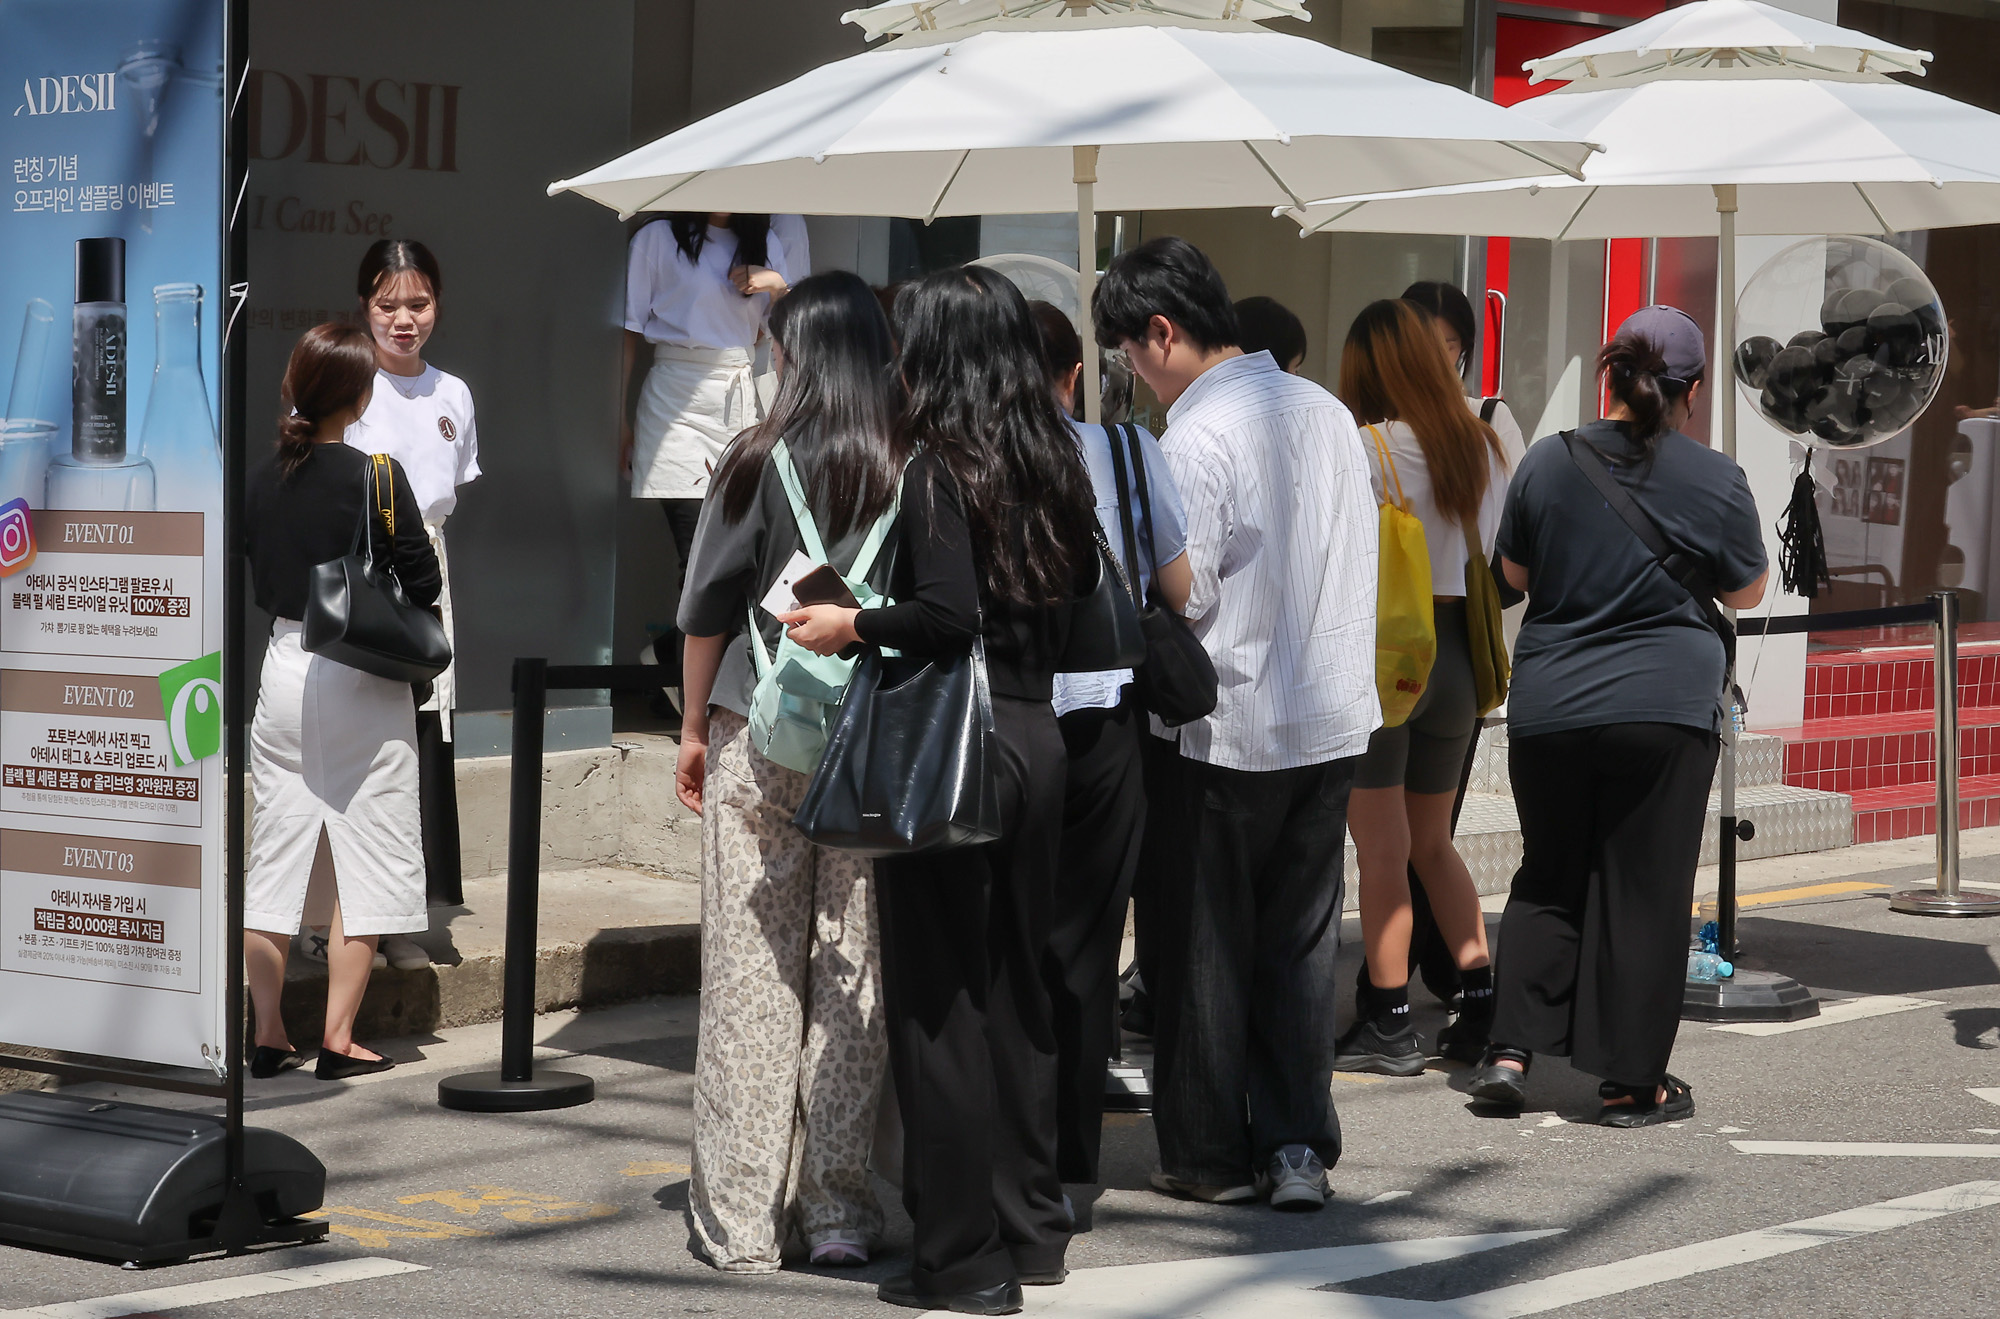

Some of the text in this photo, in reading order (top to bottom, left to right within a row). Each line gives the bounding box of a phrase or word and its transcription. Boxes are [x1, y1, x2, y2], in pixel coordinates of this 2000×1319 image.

[14, 72, 116, 117] ADESII
[14, 154, 78, 184] 런칭 기념
[13, 182, 176, 214] 오프라인 샘플링 이벤트
[275, 196, 336, 235] Can
[345, 200, 393, 237] See
[63, 523, 135, 545] EVENT 01
[26, 574, 173, 595] 아데시 공식 인스타그램 팔로우 시
[12, 592, 189, 616] 블랙 펄 세럼 트라이얼 유닛 100% 증정
[56, 622, 77, 636] 뽑기로
[86, 623, 100, 636] 없는
[100, 624, 121, 637] 혜택을
[122, 625, 158, 638] 누려보세요!
[63, 684, 135, 708] EVENT 02
[47, 728, 150, 750] 포토부스에서 사진 찍고
[30, 746, 168, 771] 아데시 태그 & 스토리 업로드 시
[4, 766, 197, 798] 블랙 펄 세럼 본품 or 올리브영 3만원권 증정
[63, 846, 134, 873] EVENT 03
[51, 889, 146, 915] 아데시 자사몰 가입 시
[36, 911, 163, 941] 적립금 30,000원 즉시 지급
[80, 939, 94, 952] 카드
[95, 941, 115, 954] 100%
[116, 943, 130, 956] 당첨
[146, 946, 167, 960] 참여권
[168, 949, 182, 962] 증정
